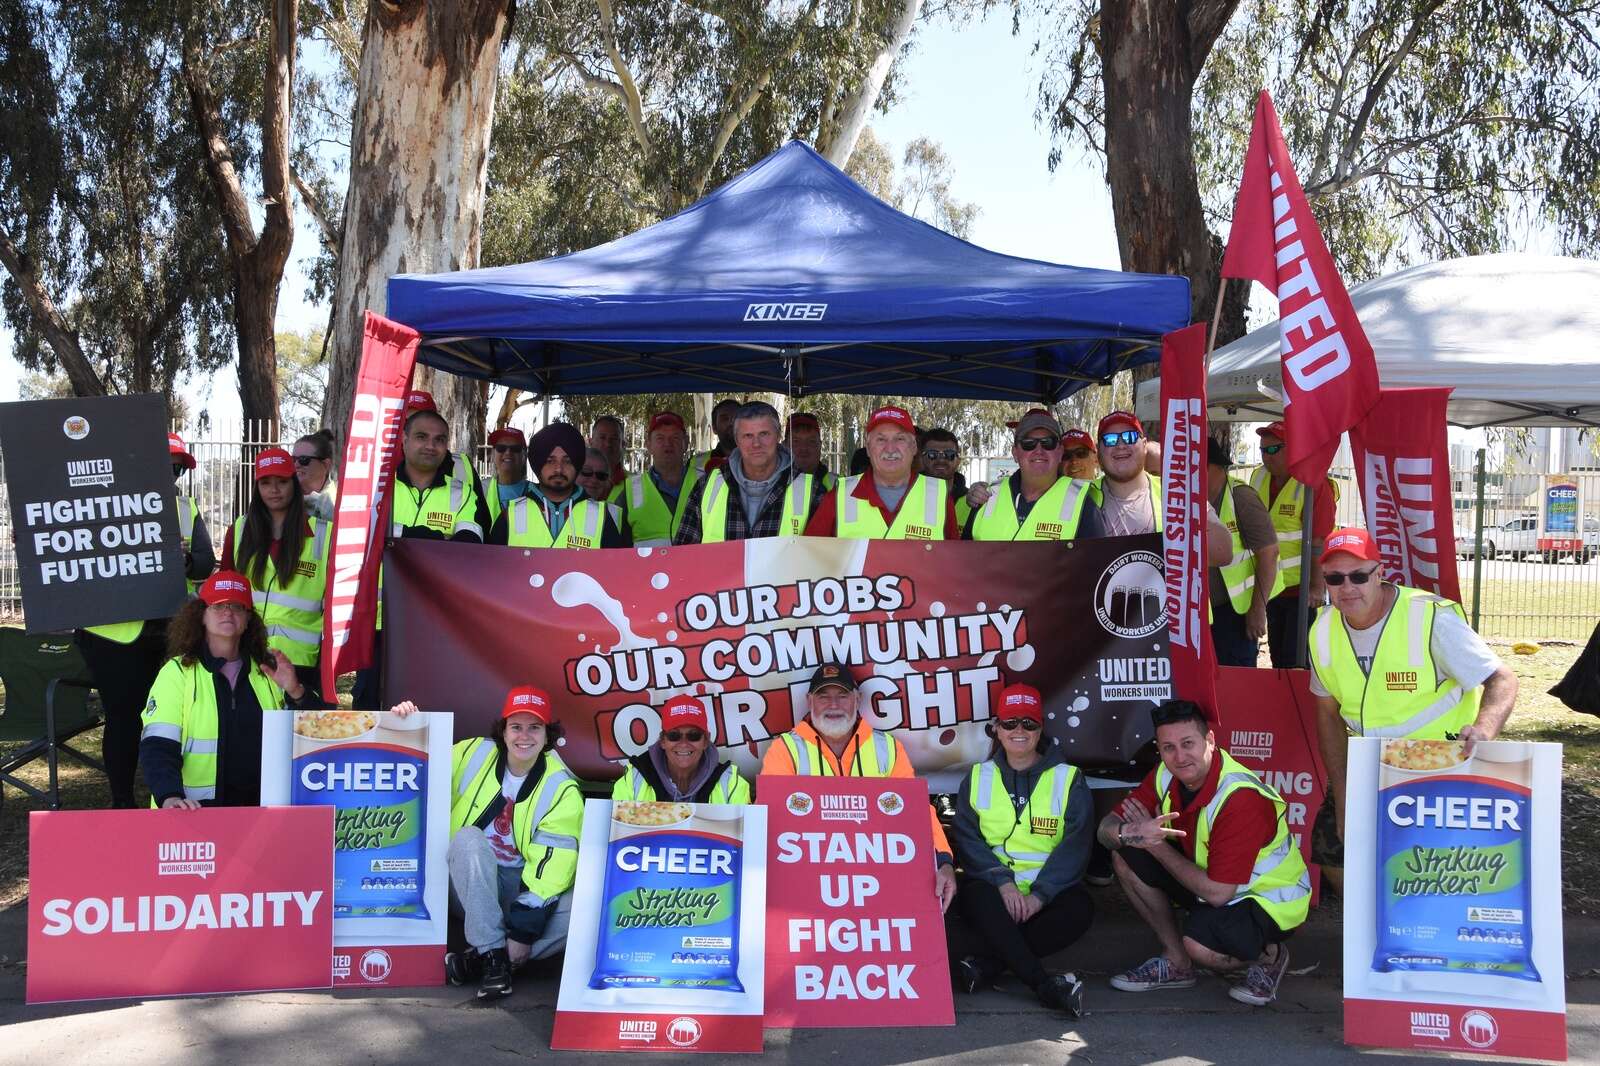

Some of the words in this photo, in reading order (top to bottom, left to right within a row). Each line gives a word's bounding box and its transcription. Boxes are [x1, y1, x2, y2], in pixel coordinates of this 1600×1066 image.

[1268, 155, 1352, 392] NITED
[744, 303, 828, 321] KINGS
[67, 459, 113, 475] UNITED
[1166, 410, 1187, 542] WORKERS
[25, 492, 163, 526] FIGHTING
[427, 511, 453, 522] UNITED
[34, 528, 94, 555] FOR
[100, 521, 163, 548] OUR
[905, 524, 932, 537] UNITED
[1036, 523, 1062, 533] UNITED
[1394, 458, 1441, 595] UNI
[40, 550, 163, 584] FUTURE!
[1109, 555, 1130, 575] DAIRY
[1131, 553, 1164, 570] WORKERS
[684, 584, 778, 631] OUR
[792, 575, 903, 618] JOBS
[1166, 548, 1184, 635] UNION
[1098, 607, 1115, 630] UNITED
[1116, 623, 1155, 636] WORKERS
[1154, 605, 1169, 626] UNI
[574, 644, 689, 696] OUR
[699, 609, 1024, 682] COMMUNITY
[1100, 657, 1171, 682] UNITED
[1386, 672, 1417, 682] UNITED
[789, 665, 999, 732] GHT
[1104, 688, 1142, 698] WORKERS
[1144, 686, 1169, 697] UNION
[1231, 731, 1273, 746] UNITED
[301, 762, 419, 791] CHEER
[820, 795, 867, 809] UNITED
[1387, 795, 1522, 831] CHEER
[335, 806, 407, 840] triking
[1032, 816, 1059, 829] UNITED
[159, 842, 216, 861] UNITED
[335, 827, 383, 851] rkers
[777, 832, 916, 863] STAND
[161, 864, 192, 873] WORKERS
[193, 863, 213, 872] UNION
[616, 846, 734, 875] CHEER
[1405, 845, 1508, 885] Striking
[820, 875, 880, 907] UP
[1392, 869, 1481, 896] workers
[42, 891, 323, 936] SOLIDARITY
[616, 905, 696, 928] workers
[628, 886, 720, 919] Striking
[788, 918, 917, 953] FIGHT
[334, 956, 351, 967] TED
[1387, 957, 1443, 965] CHEER
[795, 964, 920, 1000] BACK
[619, 1020, 657, 1032] UNITED
[1410, 1012, 1450, 1027] UNITED
